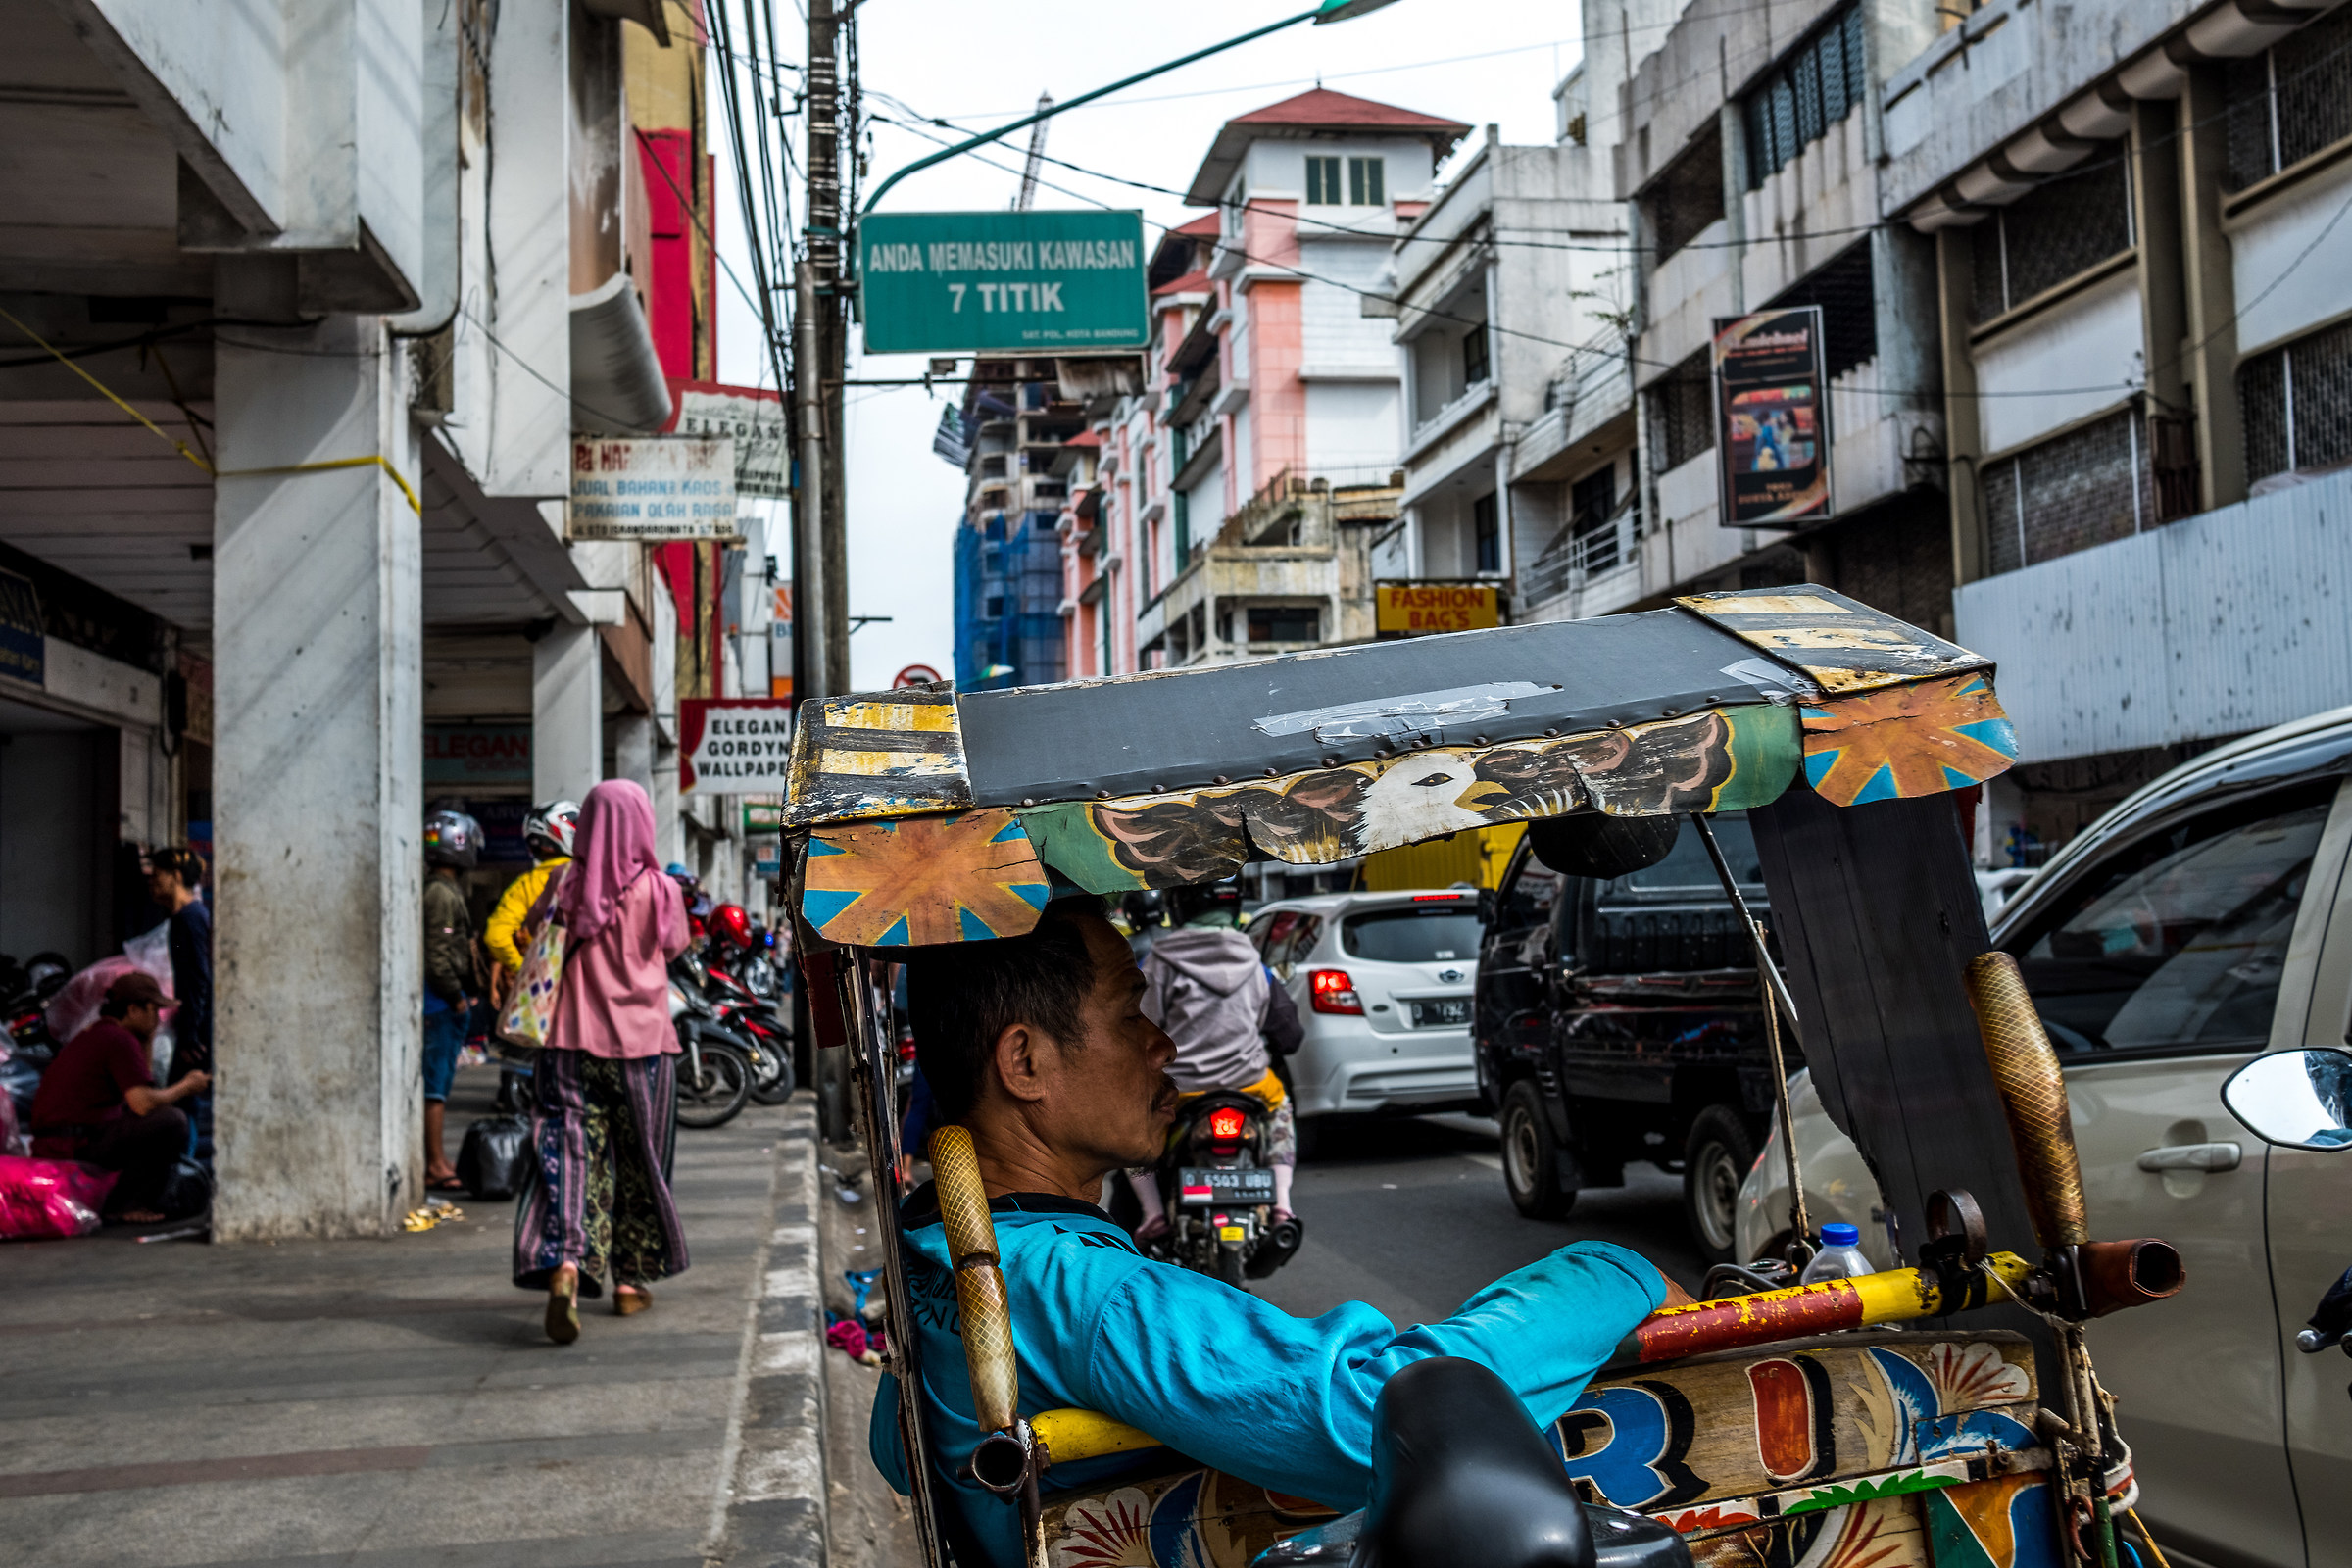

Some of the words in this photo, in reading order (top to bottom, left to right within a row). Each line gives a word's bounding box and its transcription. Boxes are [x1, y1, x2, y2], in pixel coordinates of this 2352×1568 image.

[869, 243, 924, 273] ANDA
[930, 241, 1034, 272] MEMASUKI
[1039, 239, 1136, 270] KAWASAN
[948, 282, 967, 314] 7
[977, 281, 1065, 313] TITIK
[686, 417, 780, 441] ELEGAN
[573, 479, 610, 497] JUAL
[682, 479, 722, 496] KAOS
[573, 503, 641, 519] PAKAIAN
[647, 502, 686, 519] OLAH
[692, 502, 732, 518] RAGA
[1390, 588, 1485, 608] FASHION
[1409, 610, 1471, 628] BAG'S
[712, 719, 786, 735] ELEGAN
[708, 740, 789, 757] GORDYN
[698, 761, 786, 777] WALLPAPE
